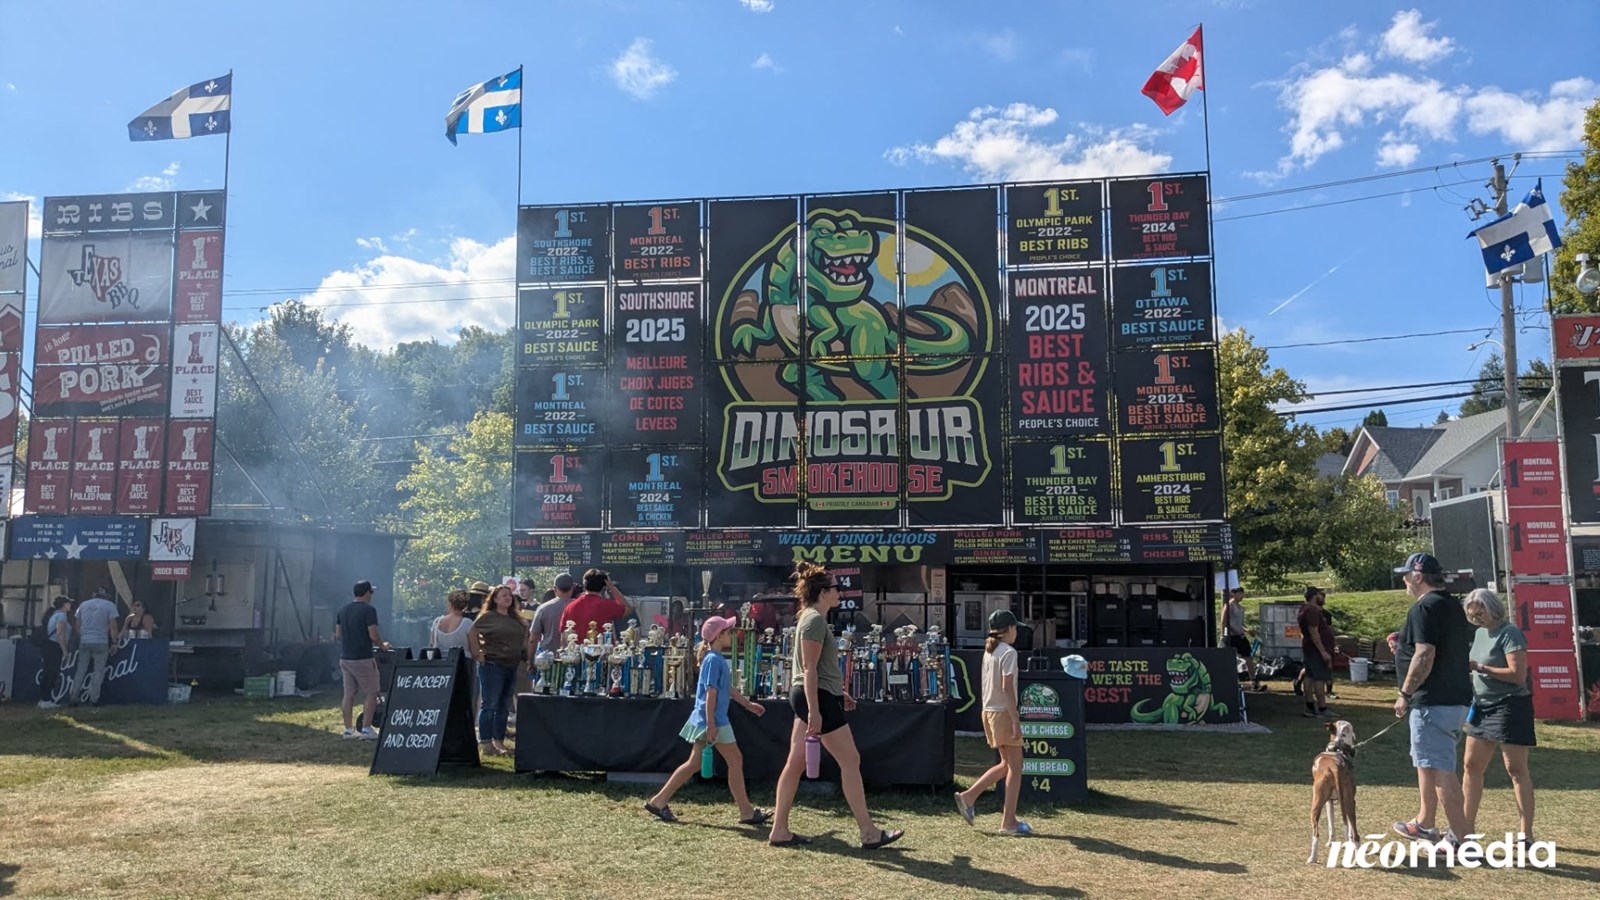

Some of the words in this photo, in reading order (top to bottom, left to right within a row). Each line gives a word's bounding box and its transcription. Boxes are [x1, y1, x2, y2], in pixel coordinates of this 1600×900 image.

[57, 201, 163, 224] RIBS
[1129, 213, 1169, 222] THUNDER
[1172, 212, 1190, 220] BAY
[1017, 217, 1061, 228] OLYMPIC
[1065, 216, 1093, 225] PARK
[1038, 227, 1072, 237] 2022
[1142, 222, 1175, 233] 2024
[534, 239, 592, 247] SOUTHSHORE
[630, 236, 683, 245] MONTREAL
[1143, 234, 1160, 242] BEST
[1020, 240, 1053, 252] BEST
[1057, 238, 1089, 249] RIBS
[1153, 243, 1175, 251] SAUCE
[547, 248, 578, 256] 2022
[641, 246, 673, 255] 2022
[531, 257, 556, 265] BEST
[560, 257, 583, 265] RIBS
[624, 258, 657, 269] BEST
[661, 257, 691, 267] RIBS
[73, 247, 119, 298] TEXAS
[179, 270, 218, 280] PLACE
[531, 266, 557, 275] BEST
[560, 265, 595, 274] SAUCE
[1015, 276, 1096, 297] MONTREAL
[106, 281, 140, 310] BBQ
[620, 292, 694, 311] SOUTHSHORE
[1136, 297, 1189, 308] OTTAWA
[1026, 304, 1085, 331] 2025
[1145, 308, 1181, 318] 2022
[524, 320, 568, 330] OLYMPIC
[572, 319, 599, 328] PARK
[1122, 322, 1156, 335] BEST
[1159, 319, 1205, 332] SAUCE
[546, 329, 578, 339] 2022
[626, 318, 685, 343] 2025
[58, 338, 135, 364] PULLED
[525, 343, 555, 354] BEST
[558, 341, 598, 352] SAUCE
[1029, 334, 1083, 358] BEST
[627, 356, 687, 370] MEILLEURE
[174, 366, 215, 374] PLACE
[1019, 362, 1069, 386] RIBS
[1078, 361, 1096, 384] &
[59, 359, 144, 398] PORK
[620, 377, 653, 390] CHOIX
[658, 376, 693, 389] JUGES
[186, 389, 202, 397] BEST
[1136, 386, 1195, 395] MONTREAL
[184, 396, 203, 404] SAUCE
[630, 398, 644, 410] DE
[647, 396, 683, 410] COTES
[1022, 389, 1094, 414] SAUCE
[1148, 394, 1185, 403] 2021
[534, 402, 586, 410] MONTREAL
[1128, 405, 1160, 415] BEST
[1164, 404, 1192, 413] RIBS
[544, 412, 576, 420] 2022
[1128, 415, 1159, 425] BEST
[1162, 413, 1206, 423] SAUCE
[636, 417, 677, 431] LEVEES
[1019, 419, 1063, 428] PEOPLE'S
[1065, 418, 1099, 427] CHOICE
[525, 424, 554, 434] BEST
[557, 423, 595, 433] SAUCE
[729, 406, 978, 472] DINOSAUR
[31, 461, 69, 470] PLACE
[75, 462, 114, 471] PLACE
[120, 460, 160, 470] PLACE
[168, 461, 209, 470] PLACE
[762, 462, 943, 494] SMOKEHOUSE
[1025, 477, 1074, 486] THUNDER
[1078, 477, 1098, 485] BAY
[1136, 472, 1206, 483] AMHERSTBURG
[41, 485, 56, 493] BEST
[131, 484, 146, 492] BEST
[536, 484, 582, 493] OTTAWA
[629, 482, 682, 490] MONTREAL
[1046, 486, 1078, 495] 2021
[1154, 484, 1191, 495] 2024
[129, 491, 148, 499] SAUCE
[177, 495, 197, 503] SAUCE
[544, 494, 573, 503] 2024
[640, 493, 670, 502] 2024
[1155, 496, 1172, 504] BEST
[1174, 496, 1191, 504] RIBS
[1025, 497, 1052, 506] BEST
[1057, 496, 1085, 505] RIBS
[637, 504, 652, 512] BEST
[1025, 507, 1053, 516] BEST
[1058, 505, 1098, 514] SAUCE
[1165, 505, 1189, 514] SAUCE
[778, 534, 820, 545] WHAT
[822, 534, 832, 544] A
[791, 546, 924, 563] MENU
[1143, 550, 1185, 558] CHICKEN
[1108, 661, 1149, 672] TASTE
[397, 676, 412, 688] WE
[412, 676, 451, 688] ACCEPT
[1092, 674, 1133, 685] WE'RE
[1136, 674, 1162, 685] THE
[390, 709, 414, 728] CASH,
[416, 709, 441, 726] DEBIT
[1040, 726, 1068, 735] CHEESE
[384, 733, 405, 748] AND
[406, 734, 437, 748] CREDIT
[1023, 739, 1048, 754] $10
[1040, 762, 1068, 772] BREAD
[1032, 777, 1050, 791] $4
